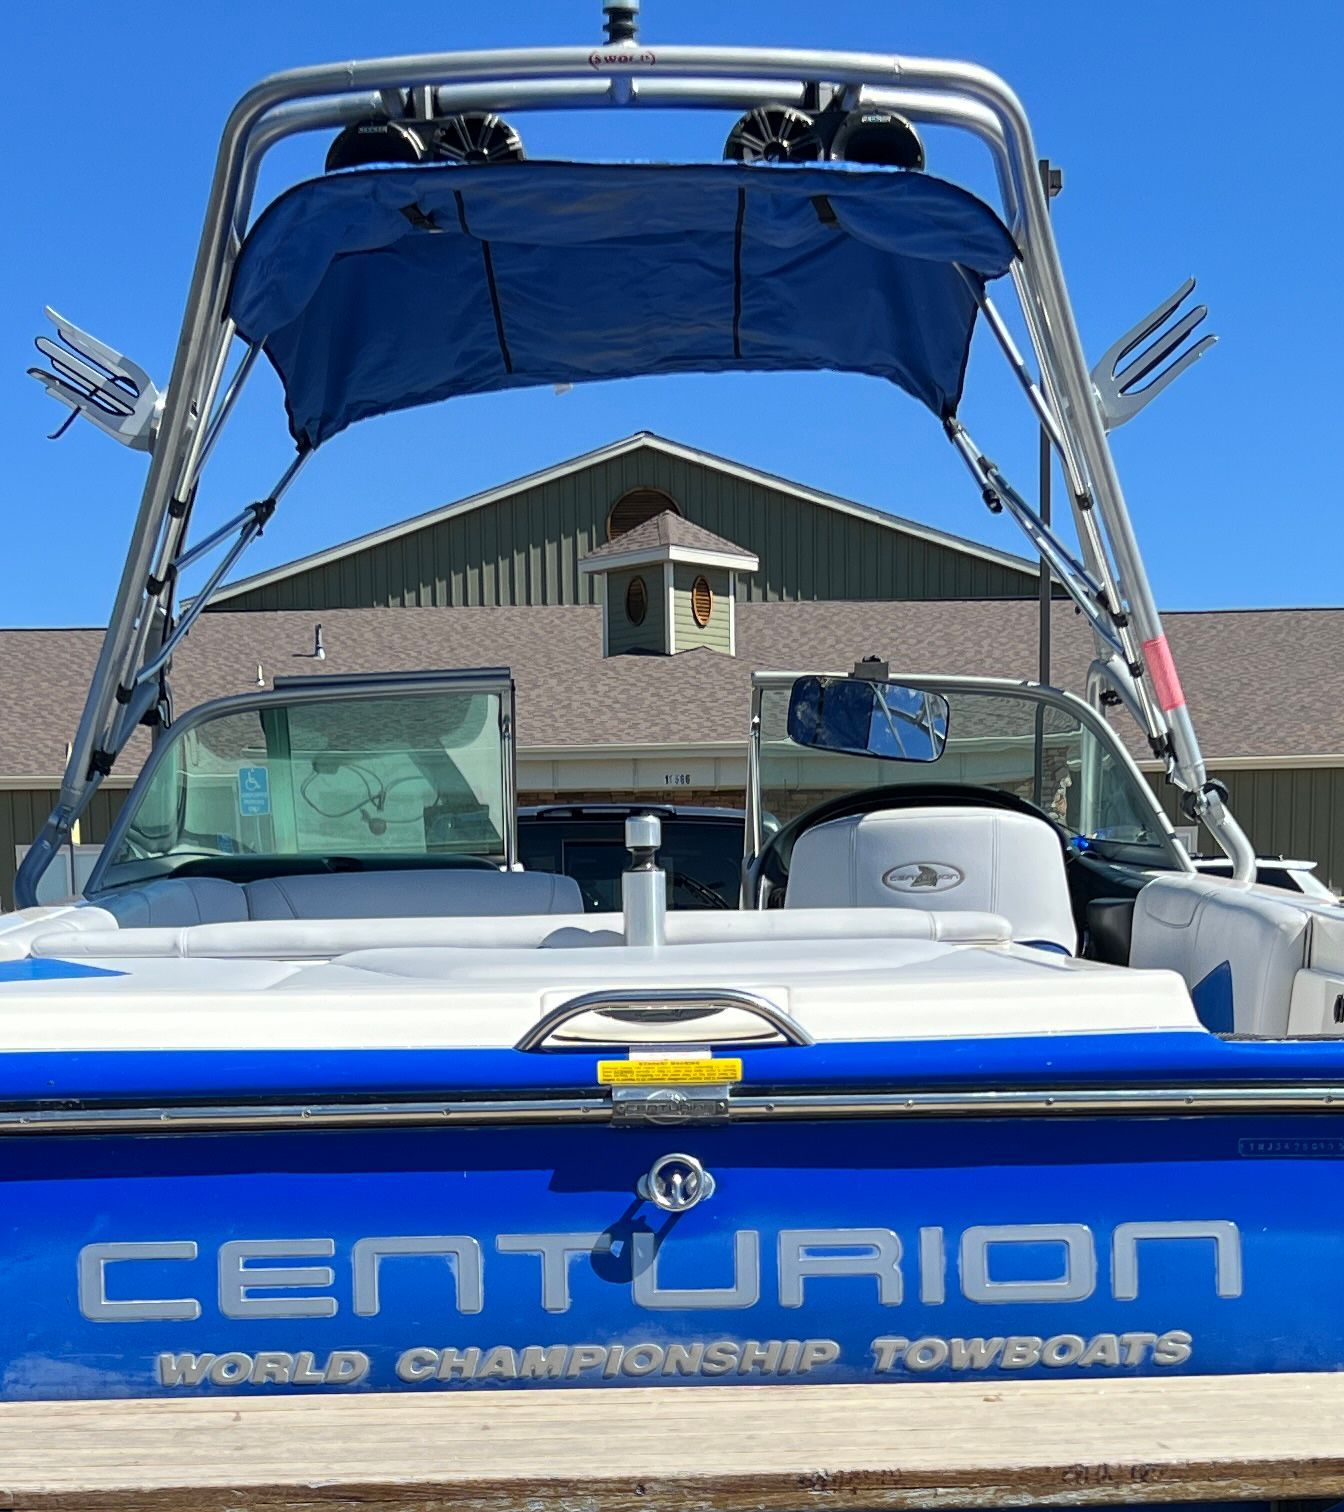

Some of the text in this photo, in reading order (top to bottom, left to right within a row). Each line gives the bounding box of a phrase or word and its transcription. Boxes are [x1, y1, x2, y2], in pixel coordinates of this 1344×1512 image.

[78, 1220, 1243, 1322] CENTURION
[157, 1330, 1193, 1386] WORLD CHAMPIONSHIP TOWBOATS
